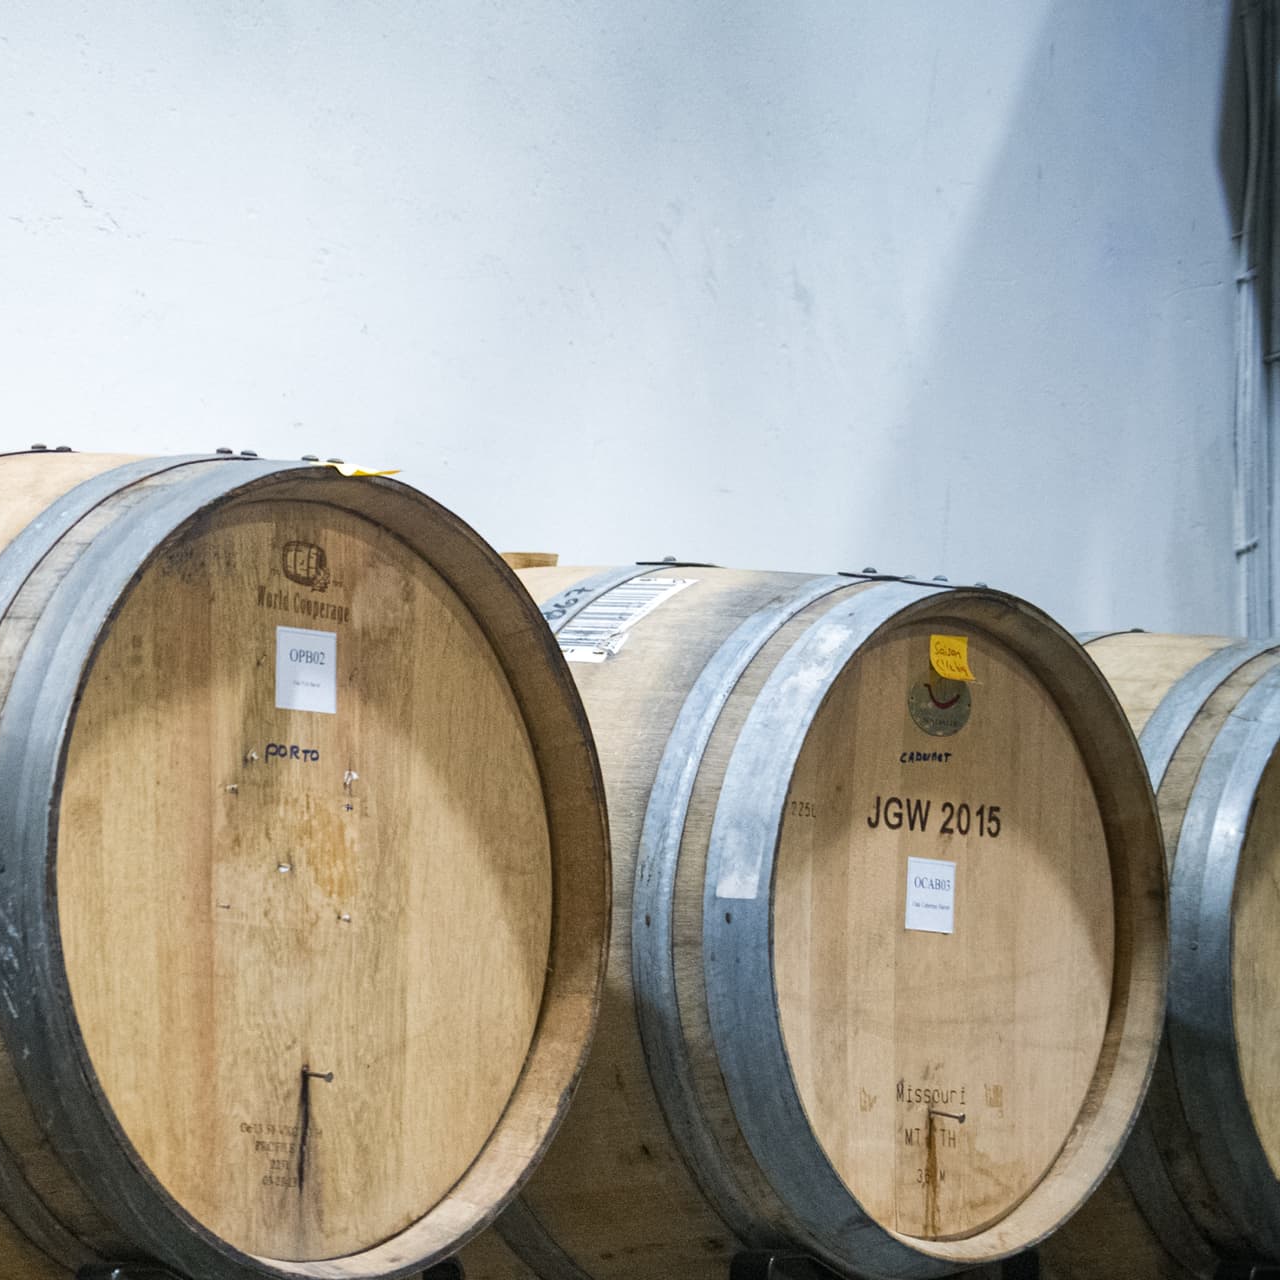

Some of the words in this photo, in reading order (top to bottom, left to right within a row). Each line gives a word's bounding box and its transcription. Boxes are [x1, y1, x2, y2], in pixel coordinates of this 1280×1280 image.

[257, 585, 289, 611] World
[293, 592, 350, 624] Cooperage
[289, 648, 326, 665] OPB02
[265, 743, 320, 763] PORTO
[867, 796, 931, 832] JGW
[940, 802, 1002, 838] 2015
[913, 876, 951, 891] OCAB03
[896, 1078, 967, 1105] Missouri
[940, 1128, 956, 1148] TH
